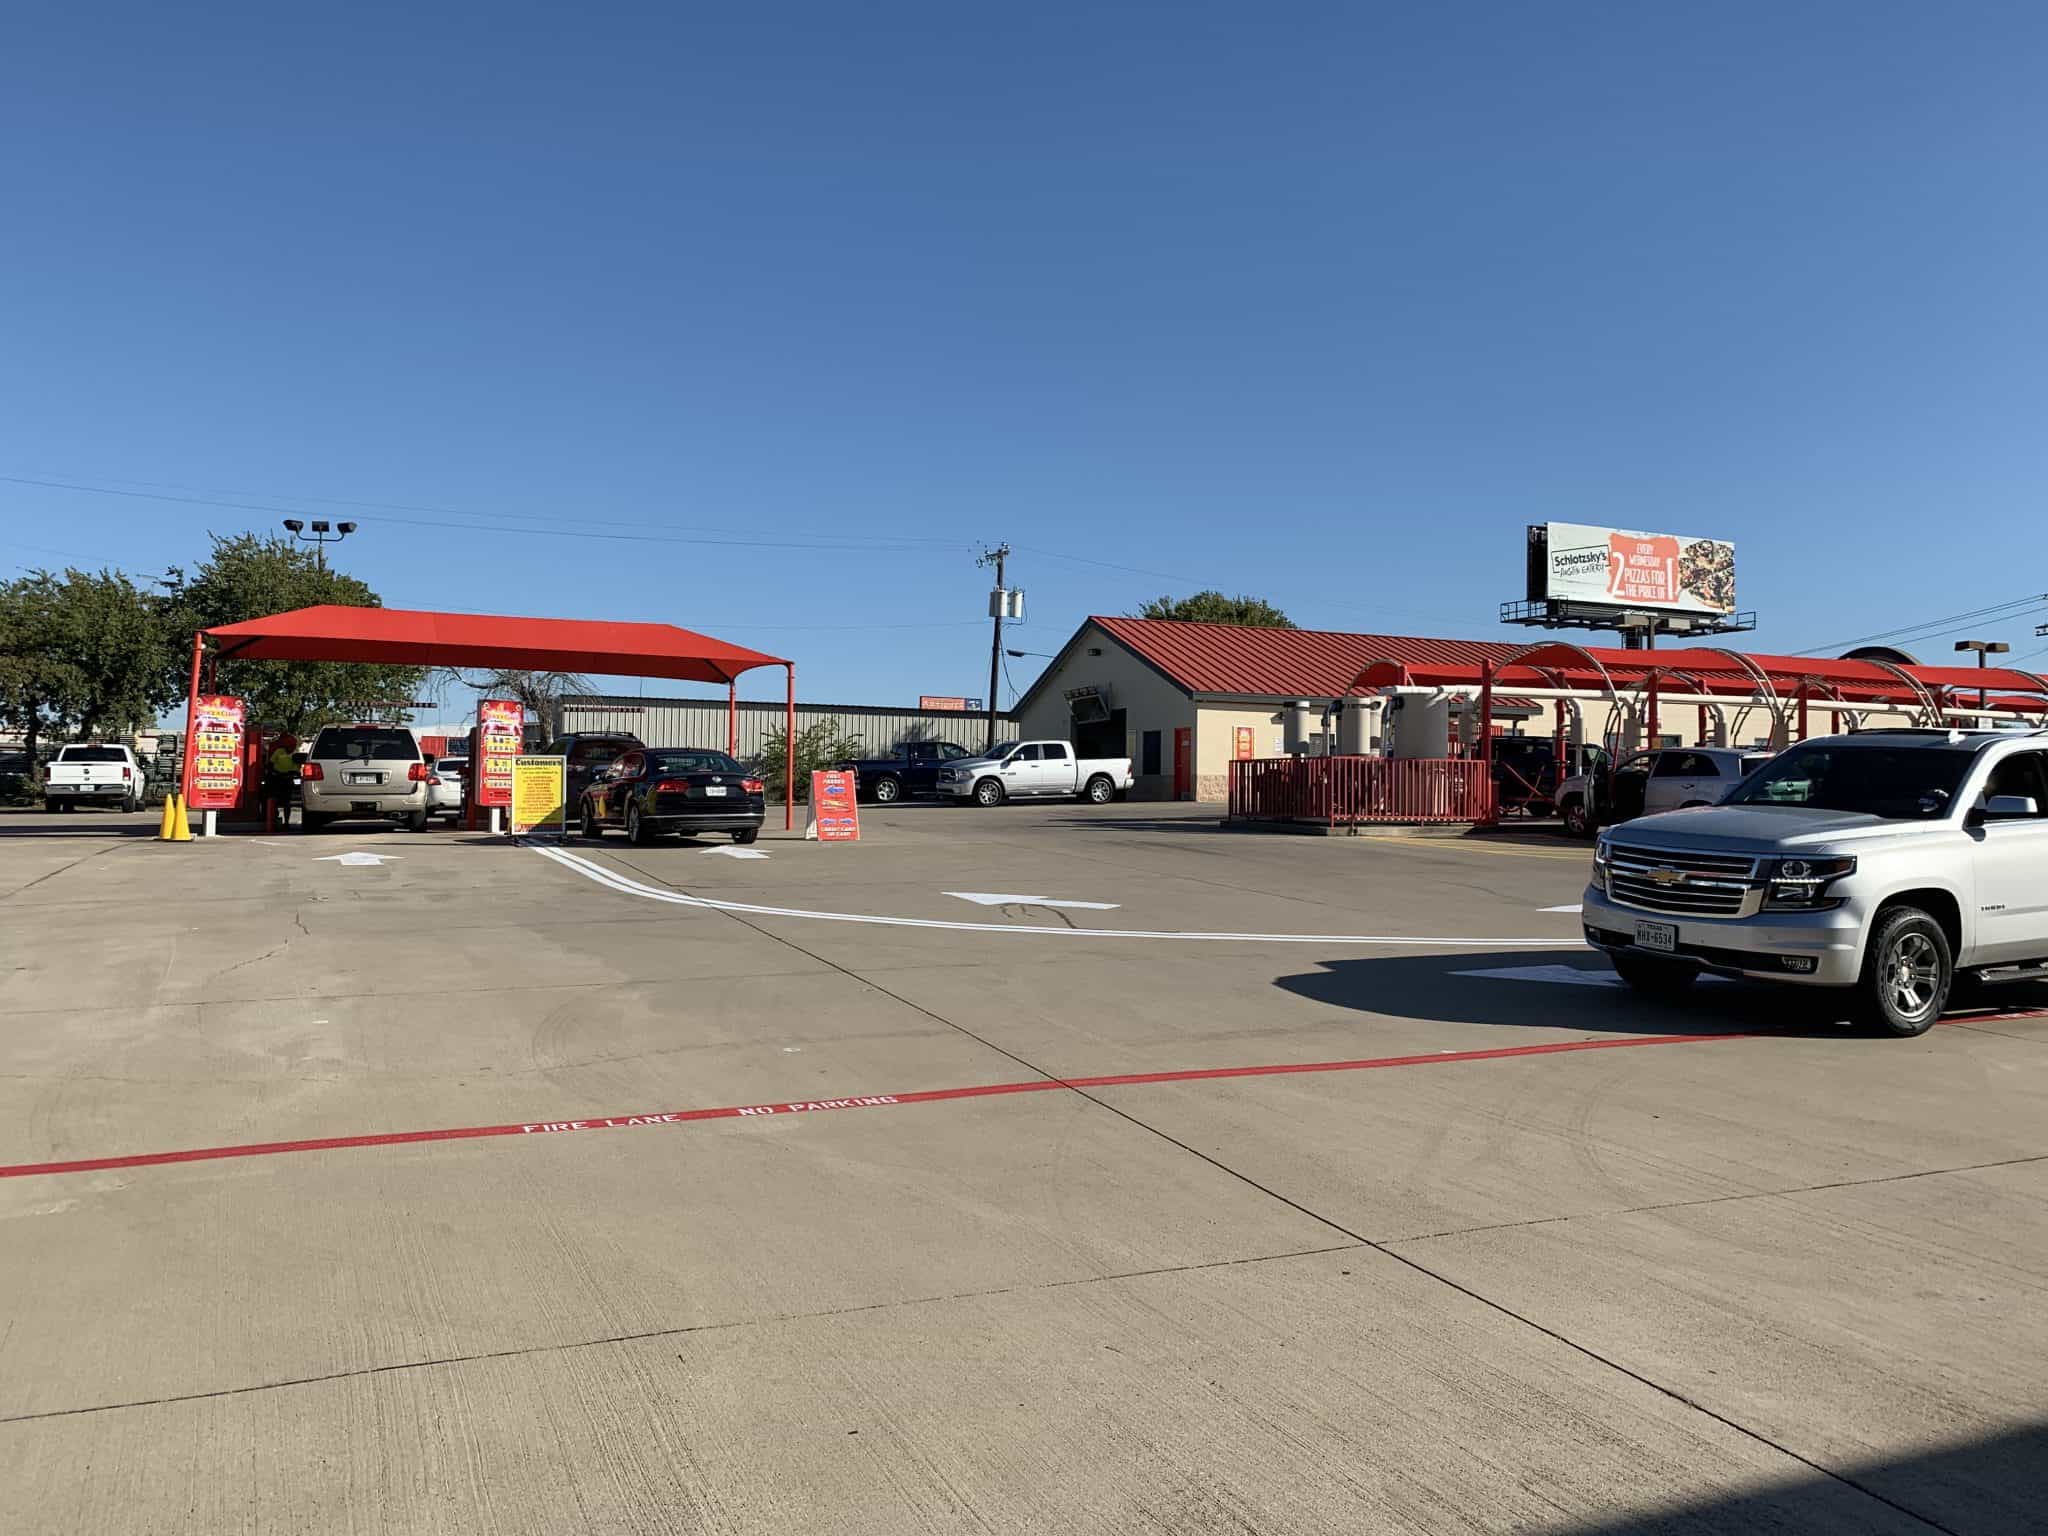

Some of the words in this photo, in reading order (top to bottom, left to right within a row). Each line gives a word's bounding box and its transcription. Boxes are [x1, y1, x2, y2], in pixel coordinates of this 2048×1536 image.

[1554, 551, 1607, 566] Schlotzsky's
[1612, 552, 1625, 597] 2
[1624, 567, 1650, 584] PIZZAS
[1651, 570, 1665, 585] FOR
[1625, 584, 1638, 597] THE
[1639, 585, 1656, 598] PRICE
[522, 1121, 589, 1133] FIRE
[605, 1114, 681, 1127] LANE
[736, 1106, 774, 1116] NO
[788, 1096, 899, 1112] PARKING
